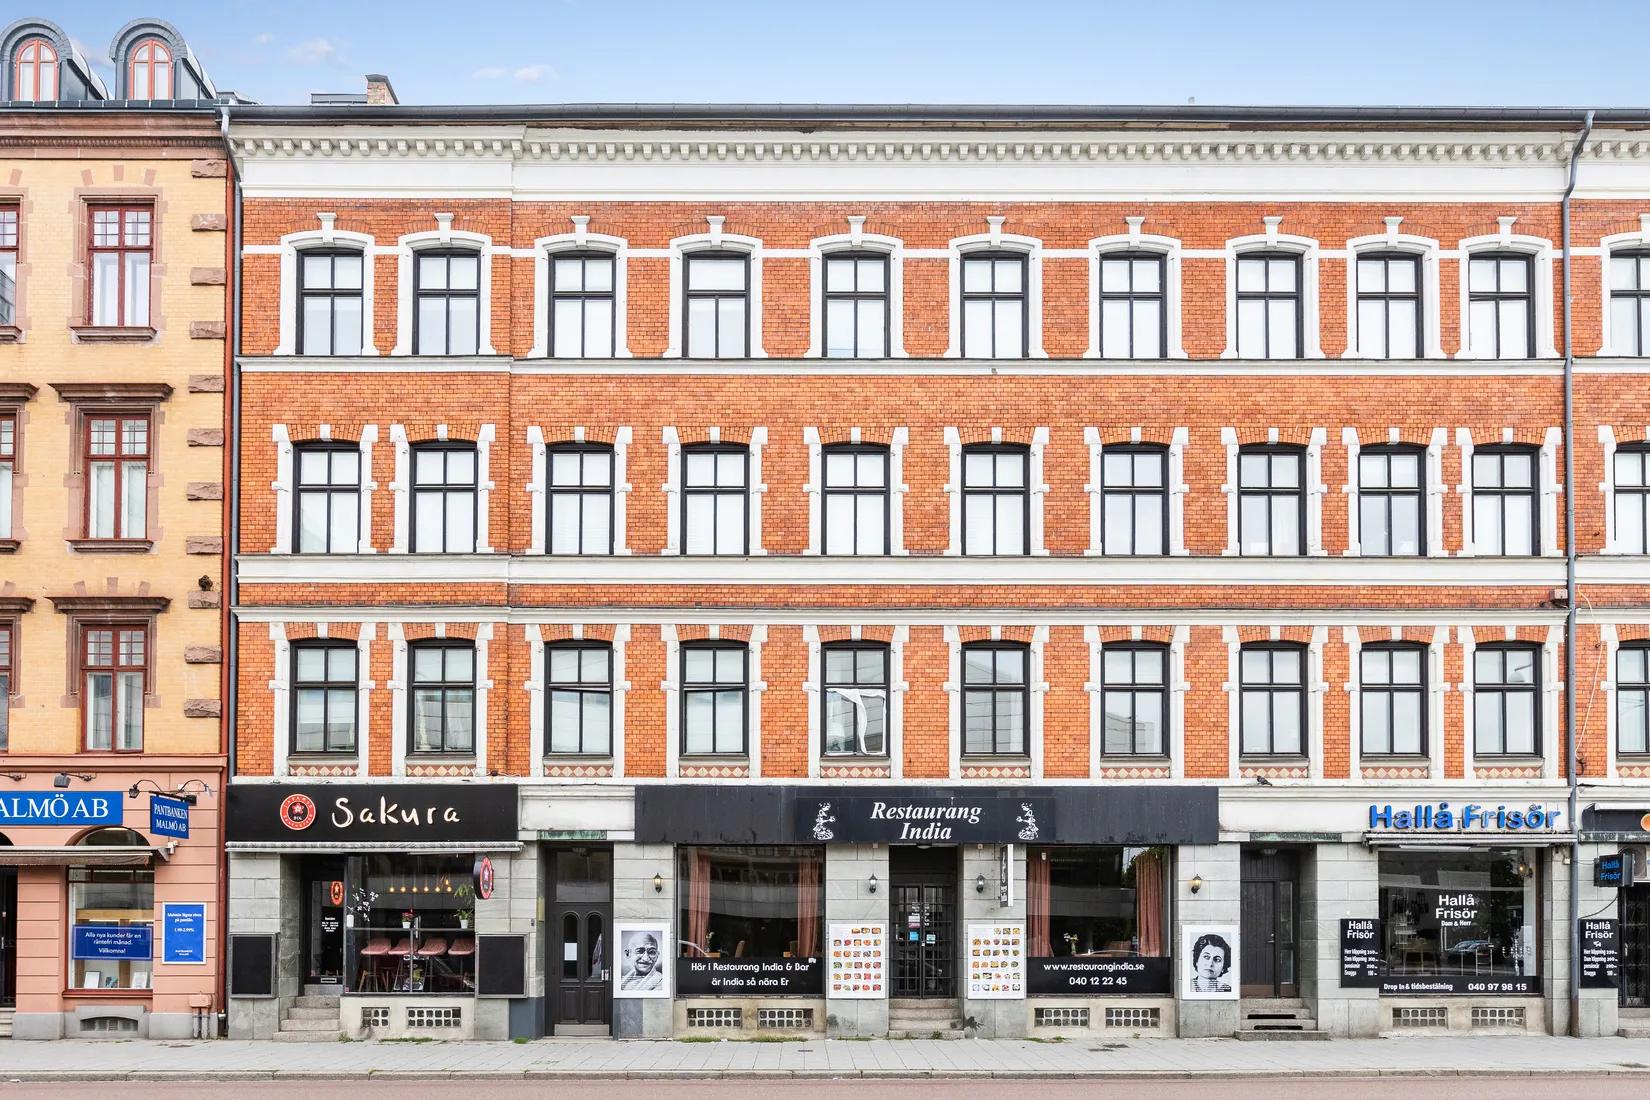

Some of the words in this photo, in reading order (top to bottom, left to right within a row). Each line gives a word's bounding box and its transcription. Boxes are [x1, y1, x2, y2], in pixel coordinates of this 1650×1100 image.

[72, 798, 109, 818] AB
[154, 803, 188, 820] PANTBANKEN
[332, 796, 460, 828] Sakura
[870, 802, 982, 823] Restaurang
[1369, 802, 1455, 829] Hallå
[1462, 804, 1561, 829] Frisör
[156, 818, 177, 831] MALMÖ
[178, 822, 187, 832] AB
[900, 823, 952, 840] India
[1601, 860, 1620, 870] Hallå
[1600, 871, 1621, 881] Frisör
[1438, 893, 1475, 906] Hallå
[1435, 907, 1478, 919] Frisör
[1348, 920, 1373, 930] Hallå
[1585, 921, 1611, 930] Hallå
[1347, 930, 1375, 939] Frisör
[1585, 930, 1614, 939] Frisör
[691, 962, 706, 971] Här
[713, 963, 760, 973] Restaurang
[762, 963, 784, 971] India
[785, 963, 793, 971] &
[794, 963, 810, 971] Bar
[1043, 962, 1145, 973] www.restaurangindia.se
[711, 978, 721, 986] är
[723, 977, 745, 986] India
[746, 976, 757, 986] så
[758, 977, 779, 986] nära
[780, 977, 790, 986] Er
[1069, 977, 1087, 986] 040
[1090, 977, 1100, 986] 12
[1102, 977, 1114, 986] 22
[1116, 977, 1128, 986] 45
[1383, 983, 1398, 991] Drop
[1468, 983, 1486, 992] 040
[1487, 983, 1500, 992] 97
[1501, 983, 1514, 992] 98
[1515, 983, 1528, 992] 15
